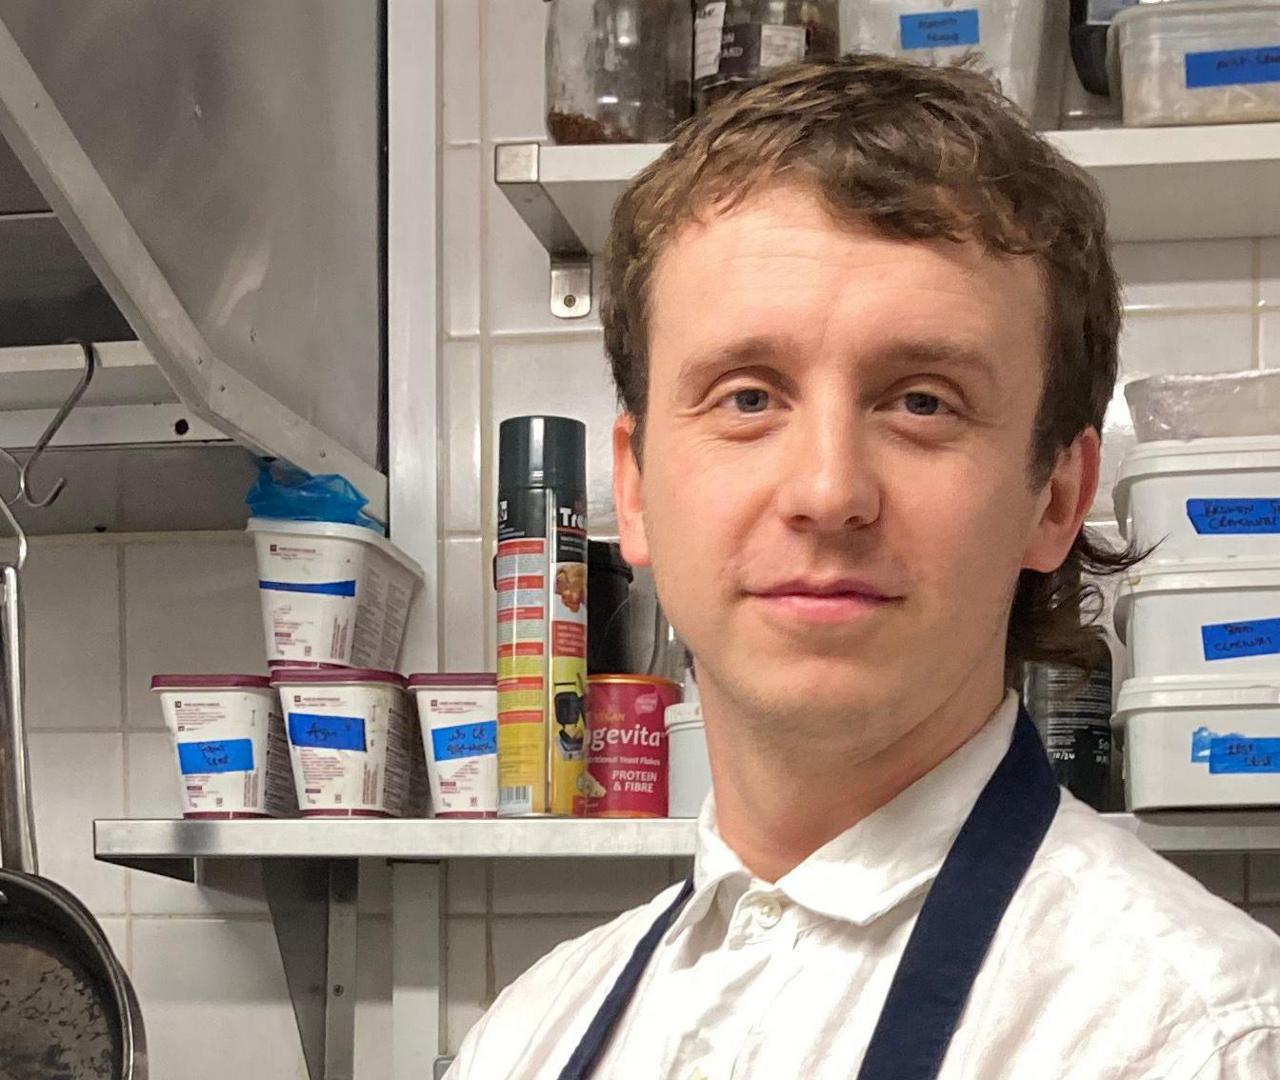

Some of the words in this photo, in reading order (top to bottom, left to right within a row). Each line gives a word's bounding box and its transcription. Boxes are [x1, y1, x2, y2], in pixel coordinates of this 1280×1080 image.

[612, 769, 658, 782] PROTEIN
[613, 781, 621, 792] &
[624, 782, 655, 794] FIBRE
